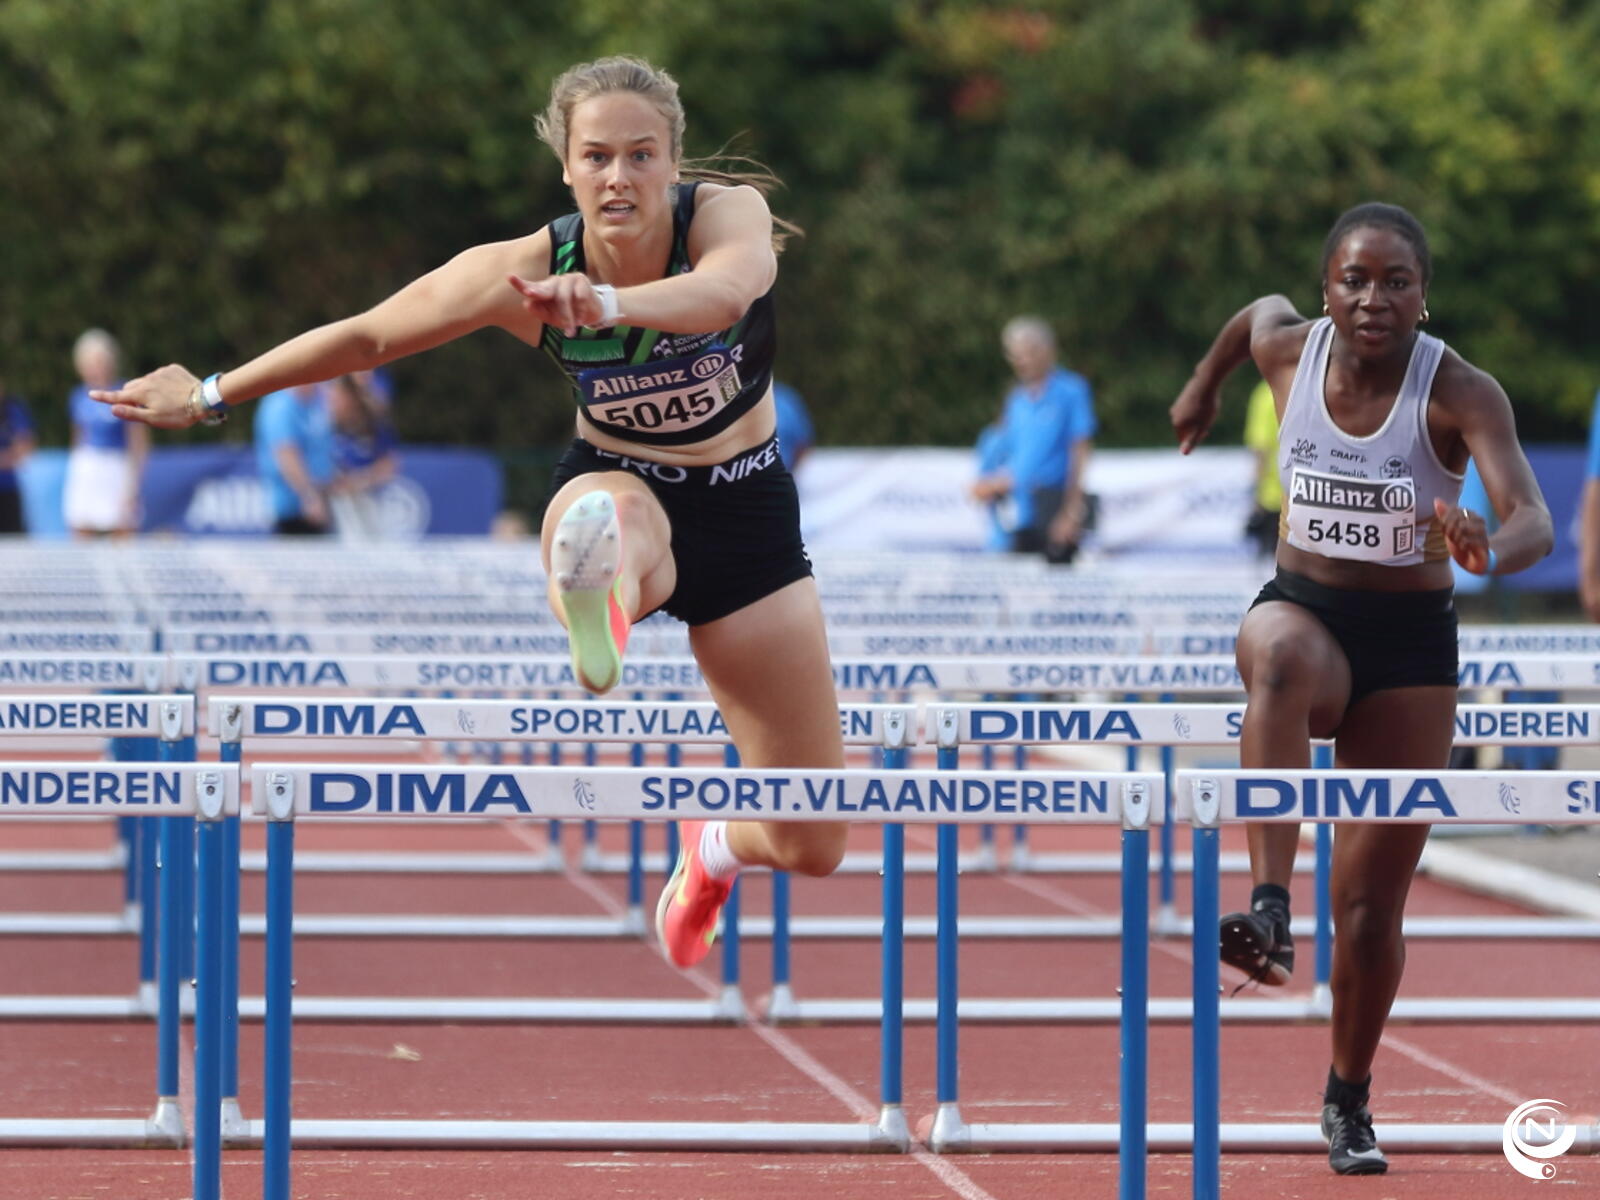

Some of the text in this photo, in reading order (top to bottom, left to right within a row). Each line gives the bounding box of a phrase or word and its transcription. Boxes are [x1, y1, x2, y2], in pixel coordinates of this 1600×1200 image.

[592, 368, 688, 398] Allianz
[605, 388, 716, 430] 5045
[708, 442, 777, 487] NIKE
[1292, 475, 1377, 508] Allianz
[1307, 518, 1381, 549] 5458
[194, 633, 312, 653] DIMA
[207, 660, 348, 686] DIMA
[832, 664, 939, 689] IMA
[0, 702, 149, 729] NDEREN
[253, 703, 426, 735] DIMA
[969, 709, 1142, 741] DIMA
[1, 771, 182, 805] NDEREN
[308, 772, 1108, 813] DIMA SPORT.VLAANDEREN
[1234, 778, 1600, 818] DIMA S
